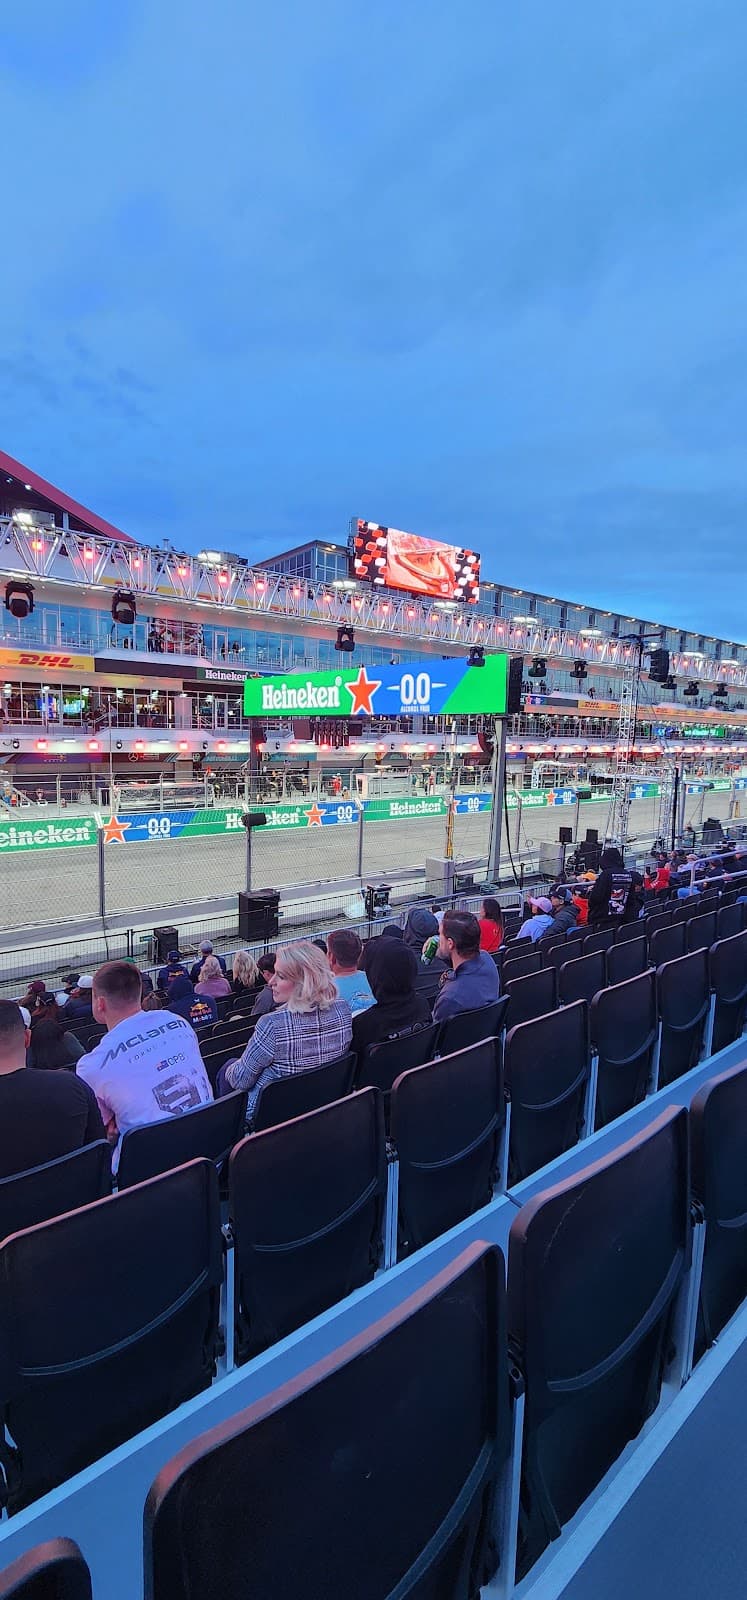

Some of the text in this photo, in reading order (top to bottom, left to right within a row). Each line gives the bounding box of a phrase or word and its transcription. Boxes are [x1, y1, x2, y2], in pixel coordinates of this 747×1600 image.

[19, 654, 74, 668] DHL
[262, 672, 430, 709] Heineken 0.0
[390, 800, 441, 816] Heineken
[0, 824, 90, 847] eineken
[100, 1020, 187, 1070] McLaren
